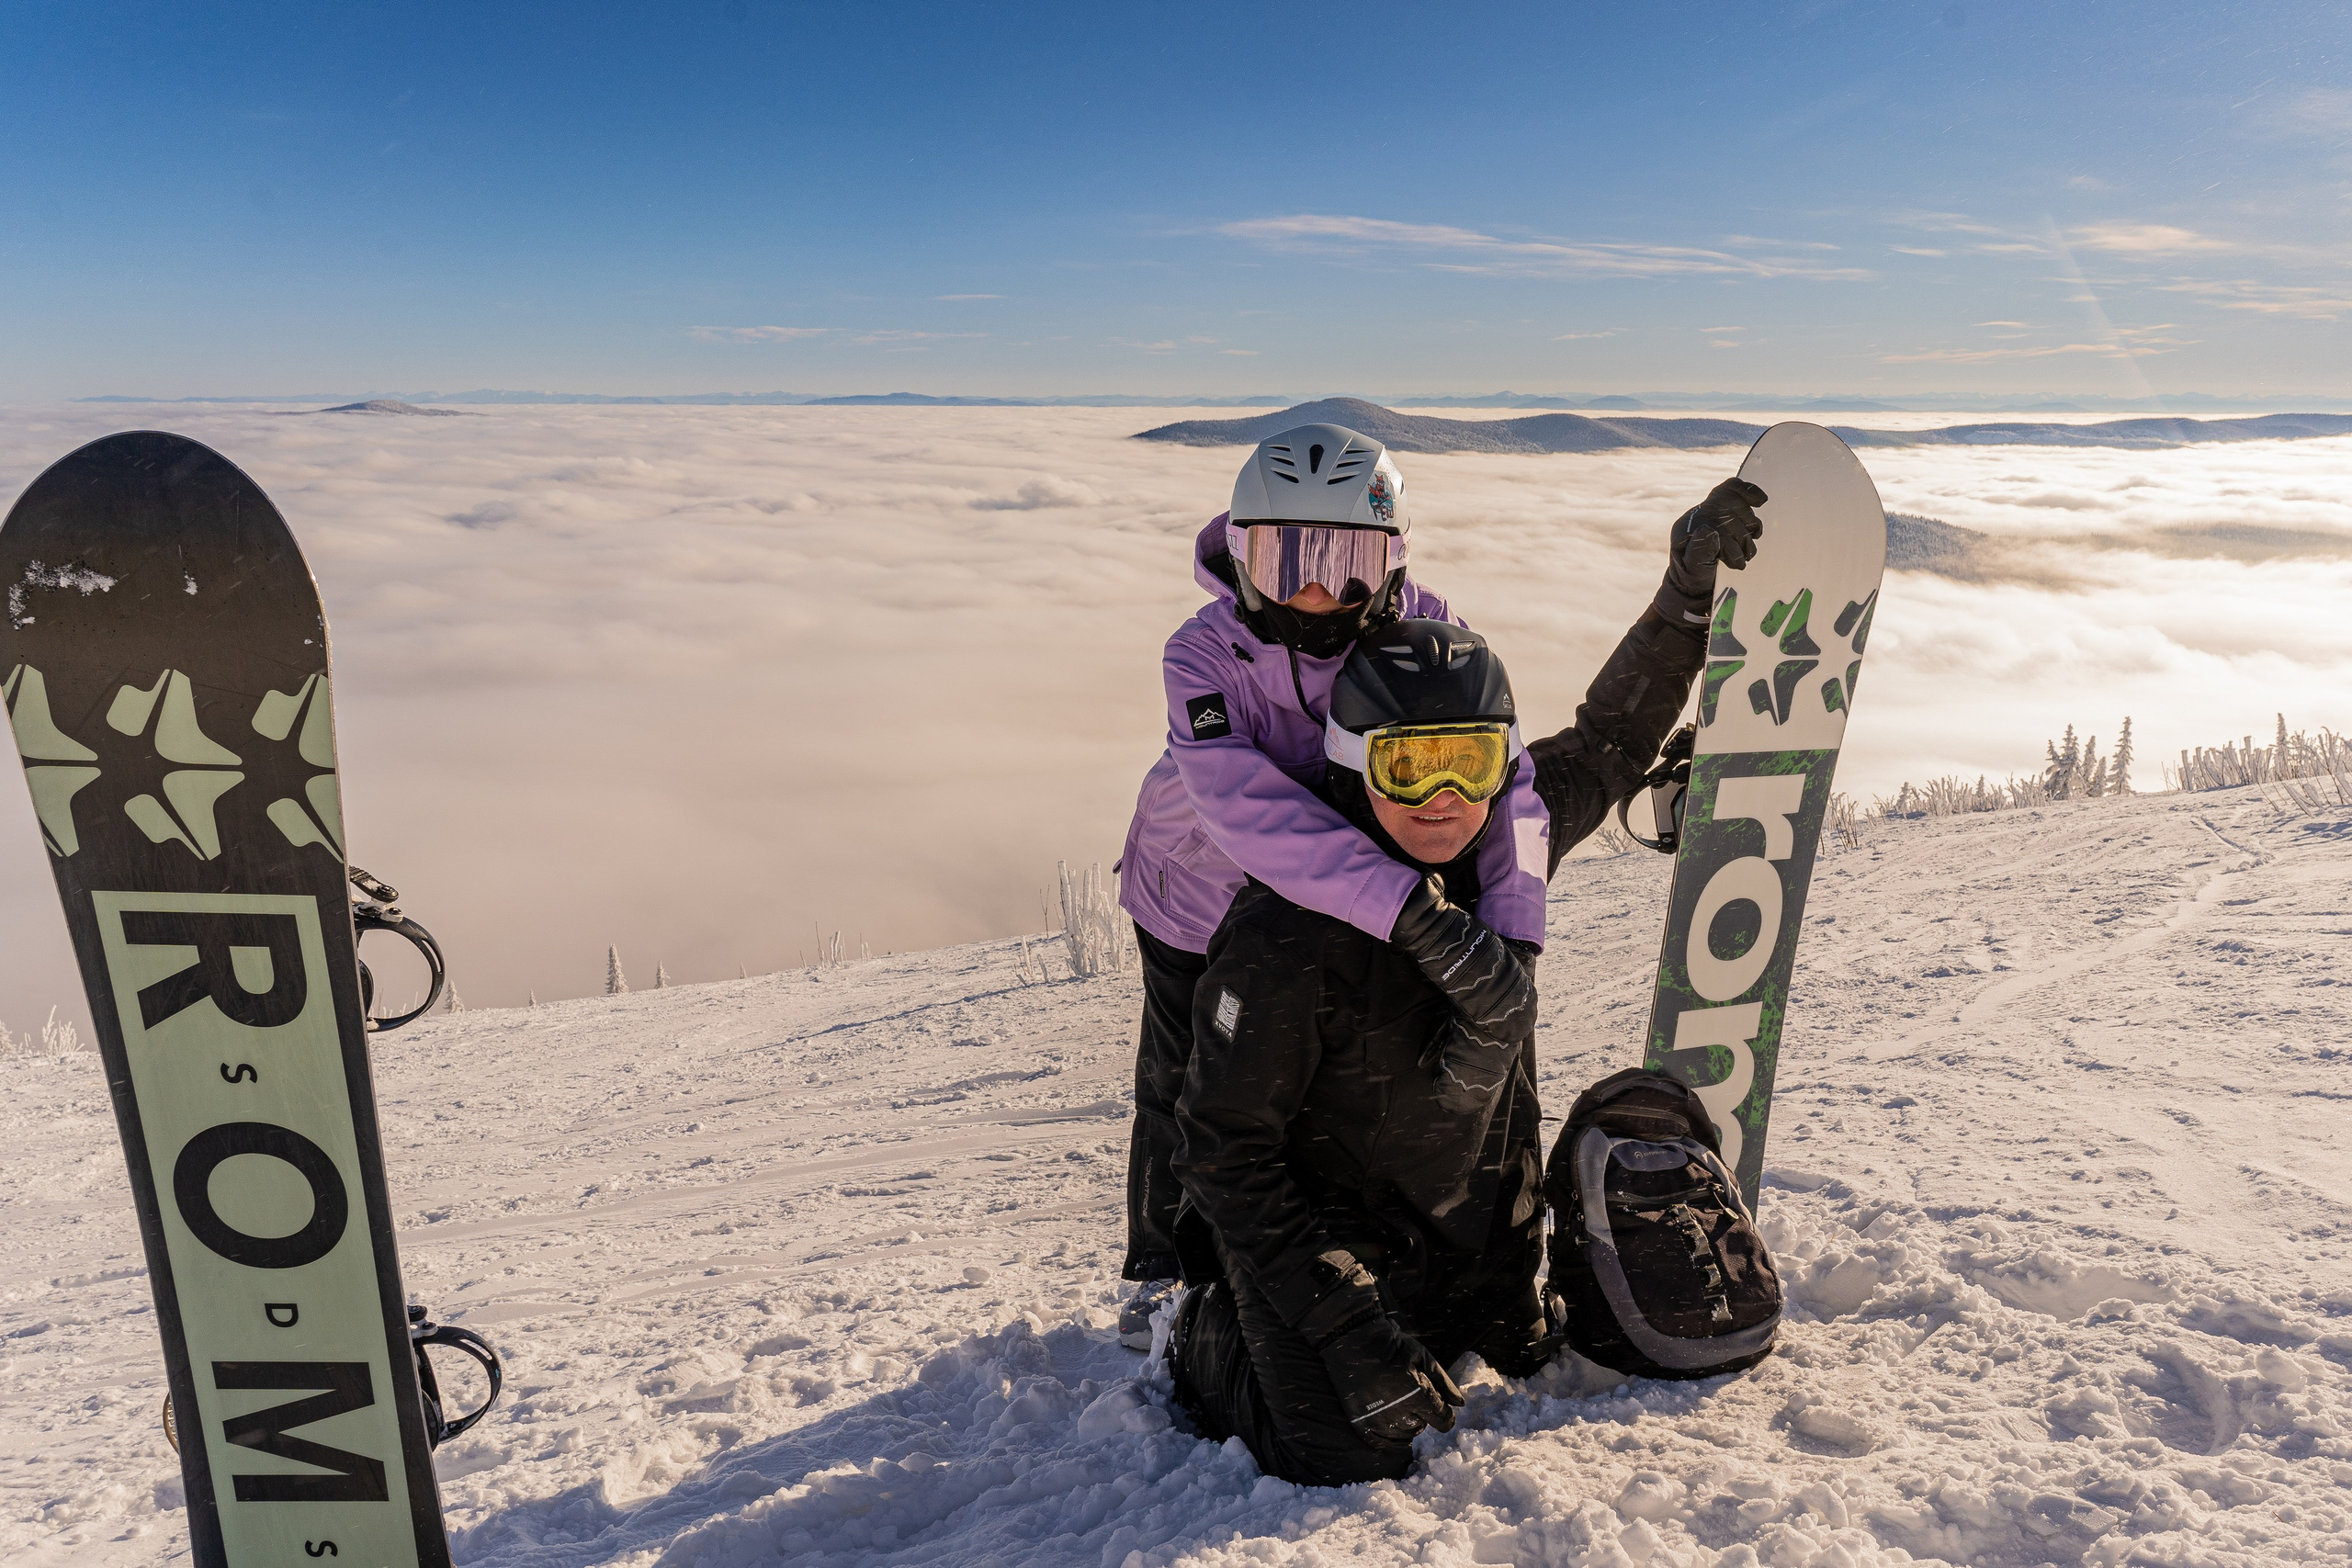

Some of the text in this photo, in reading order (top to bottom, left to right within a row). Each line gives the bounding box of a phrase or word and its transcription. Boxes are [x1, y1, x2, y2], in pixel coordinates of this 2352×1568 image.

[1442, 929, 1487, 982] MOUNTRIDE
[1215, 1020, 1232, 1037] XVOYA
[1142, 1156, 1153, 1218] MOUNTRIDE
[1365, 1399, 1385, 1411] WEDZE
